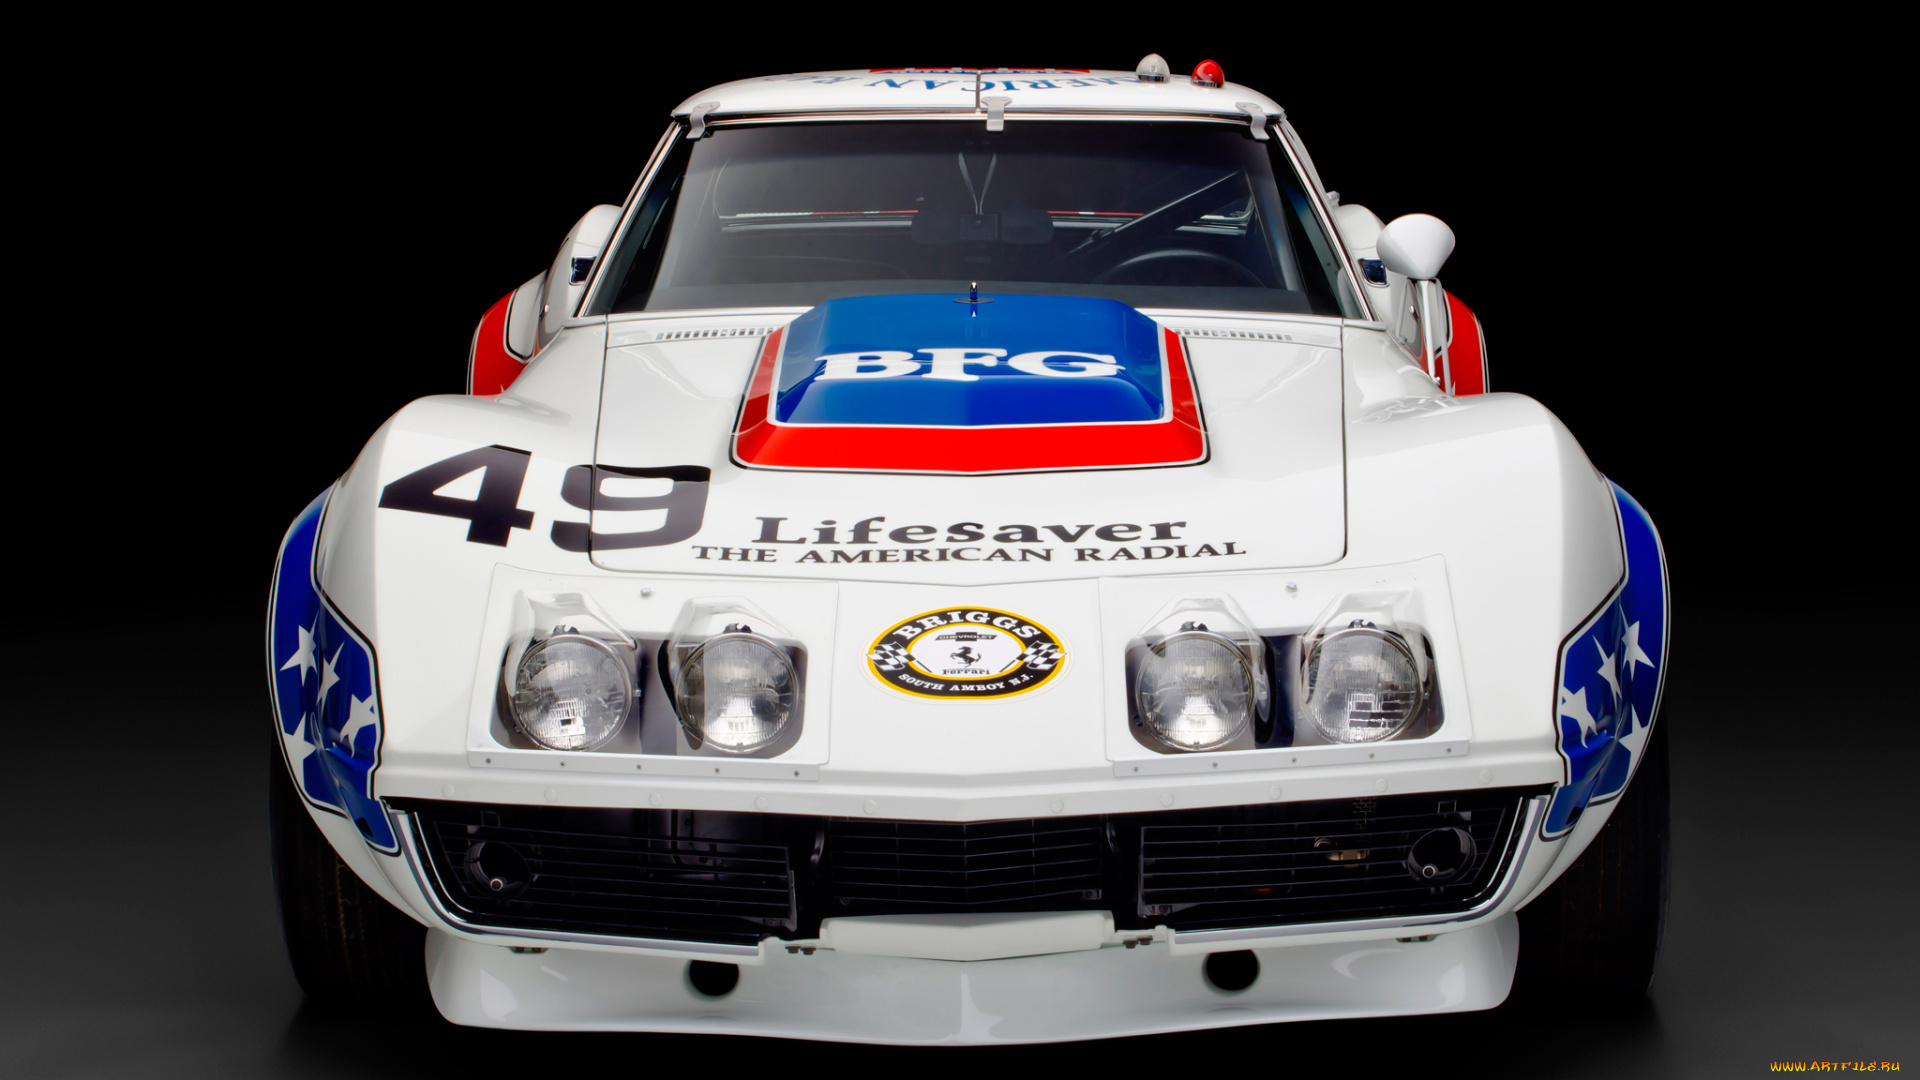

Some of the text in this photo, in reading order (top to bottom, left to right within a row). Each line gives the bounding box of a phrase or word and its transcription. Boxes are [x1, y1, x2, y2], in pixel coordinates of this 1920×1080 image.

[863, 76, 1140, 92] MERICAN
[814, 348, 1126, 381] BFG
[378, 444, 711, 552] 49
[751, 516, 1187, 545] Lifesaver
[692, 542, 1247, 563] THE AMERICAN RADIAL
[892, 611, 1041, 639] BRIGGS
[898, 673, 945, 691] SOUTH
[949, 682, 1005, 691] AMBOY
